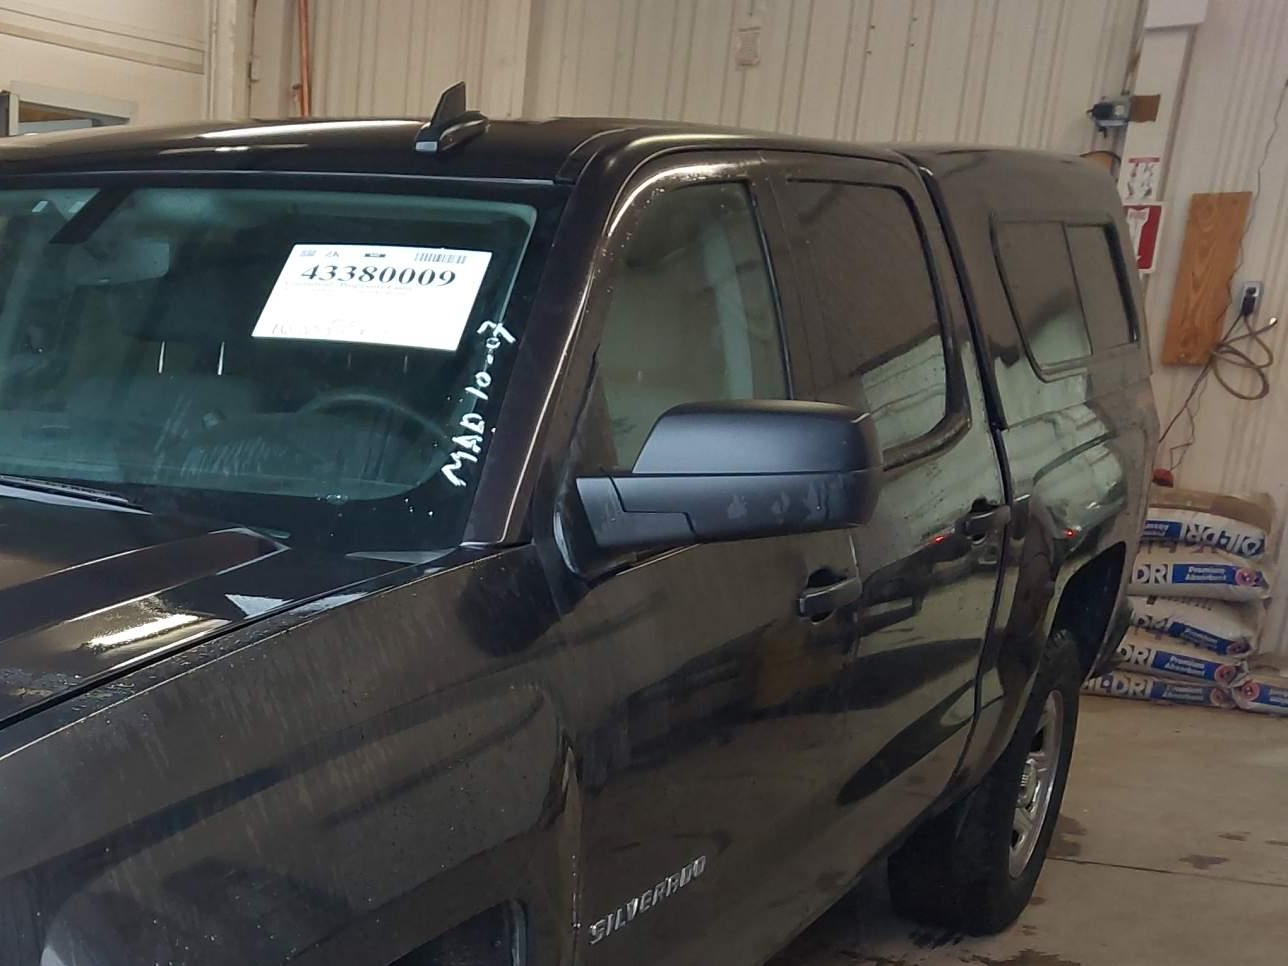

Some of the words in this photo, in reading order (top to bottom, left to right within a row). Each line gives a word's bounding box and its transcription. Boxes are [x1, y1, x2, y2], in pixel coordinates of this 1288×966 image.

[300, 264, 457, 288] 43380009
[441, 412, 487, 488] MAD
[589, 855, 707, 945] SILVERADO
